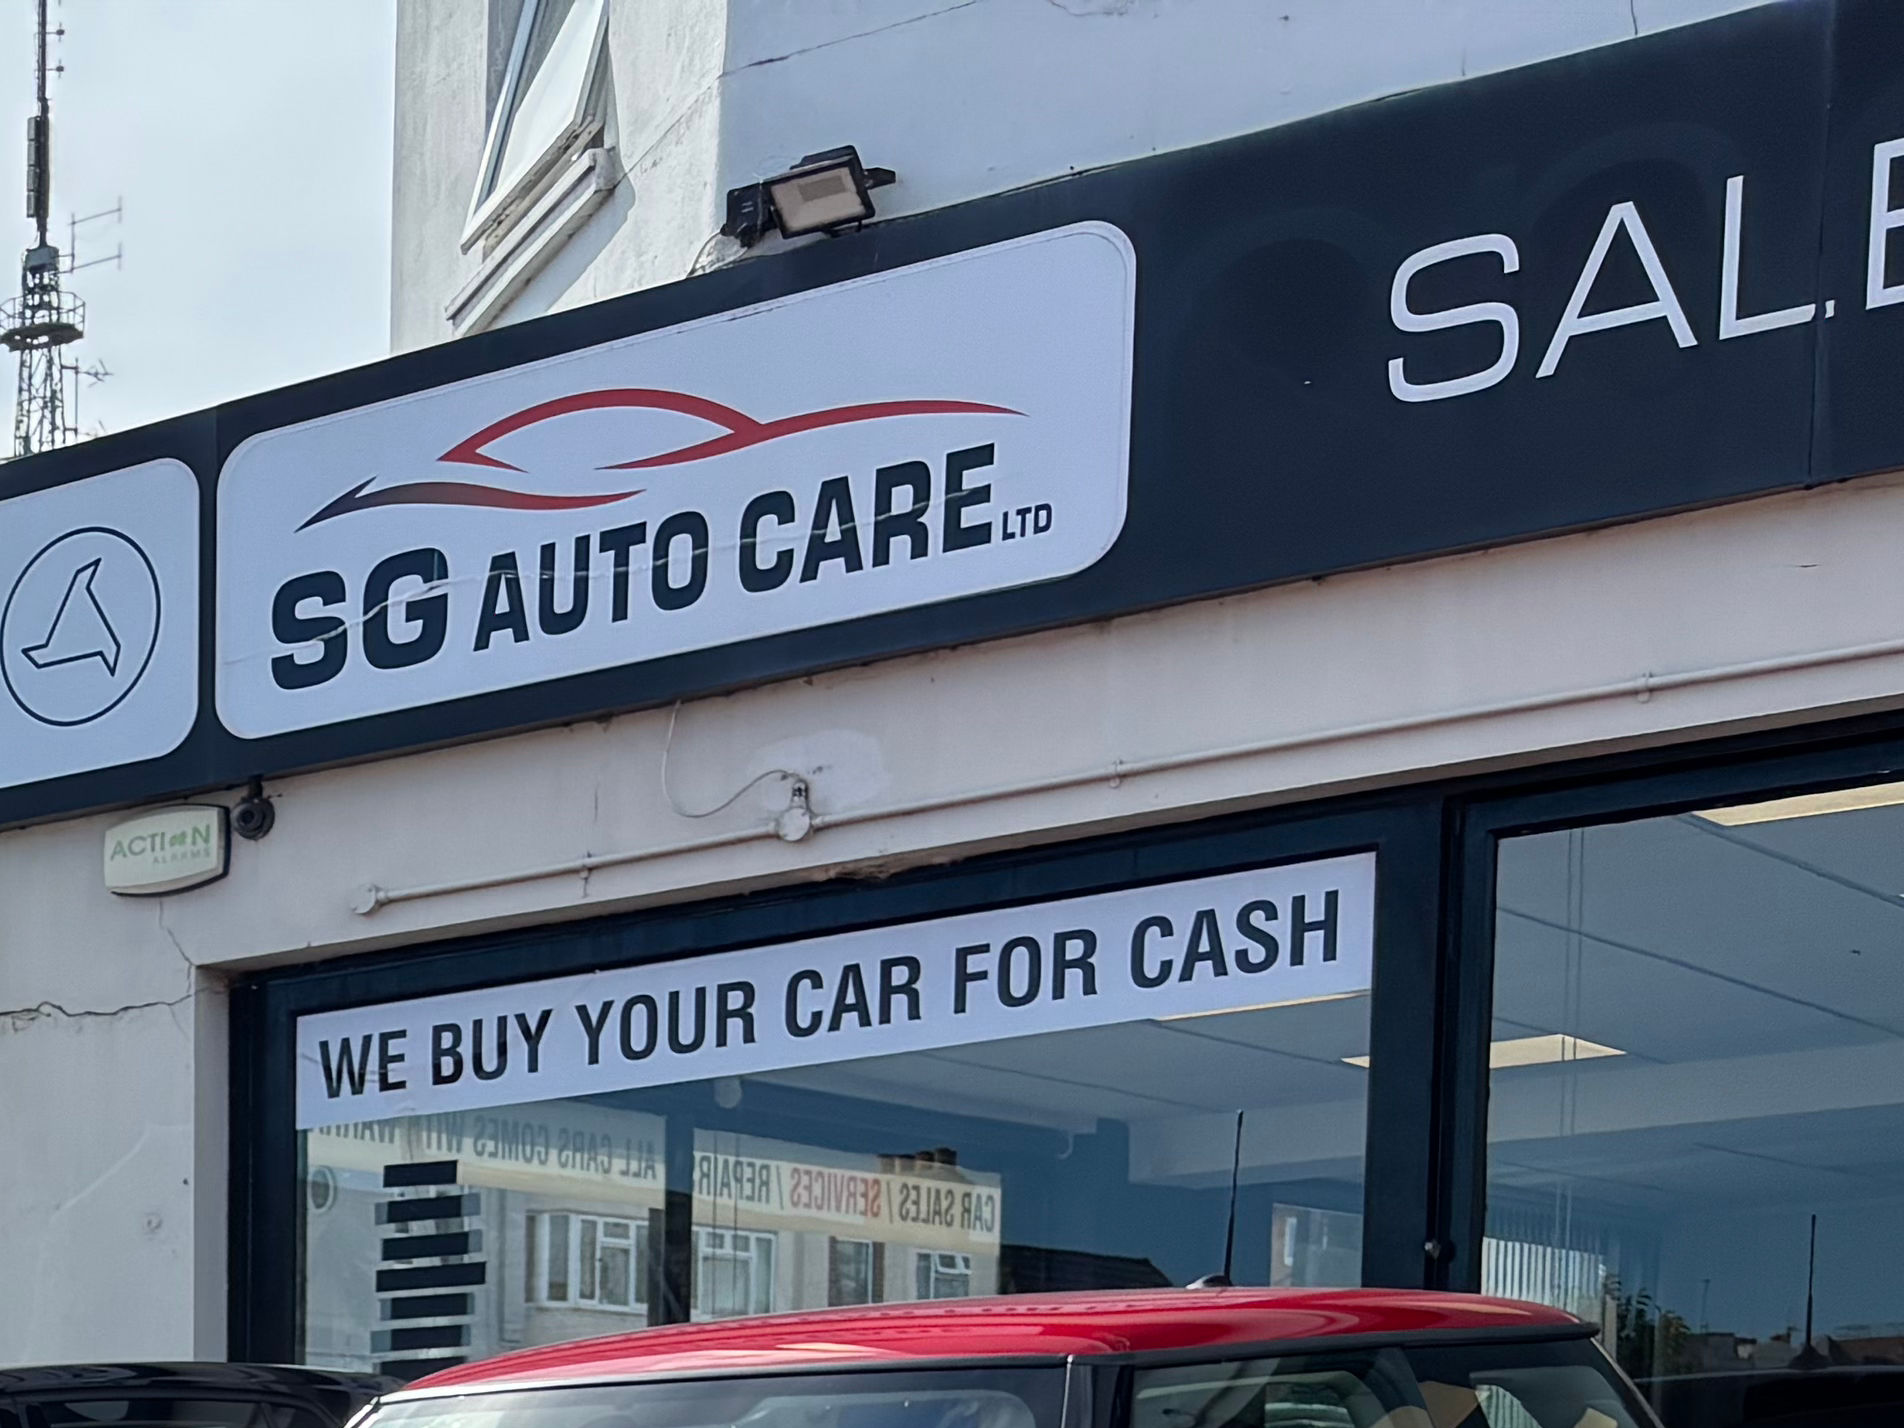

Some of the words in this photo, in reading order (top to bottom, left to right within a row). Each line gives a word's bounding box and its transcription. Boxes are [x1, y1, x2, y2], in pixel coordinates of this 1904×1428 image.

[269, 546, 449, 692] SG
[472, 511, 709, 652] AUTO
[738, 441, 996, 594] CARE
[1001, 502, 1054, 543] LTD
[318, 1028, 408, 1099] WE
[430, 1008, 553, 1087] BUY
[575, 980, 757, 1066] YOUR
[783, 955, 924, 1039] CAR
[952, 926, 1098, 1016] FOR
[1127, 888, 1342, 990] CASH
